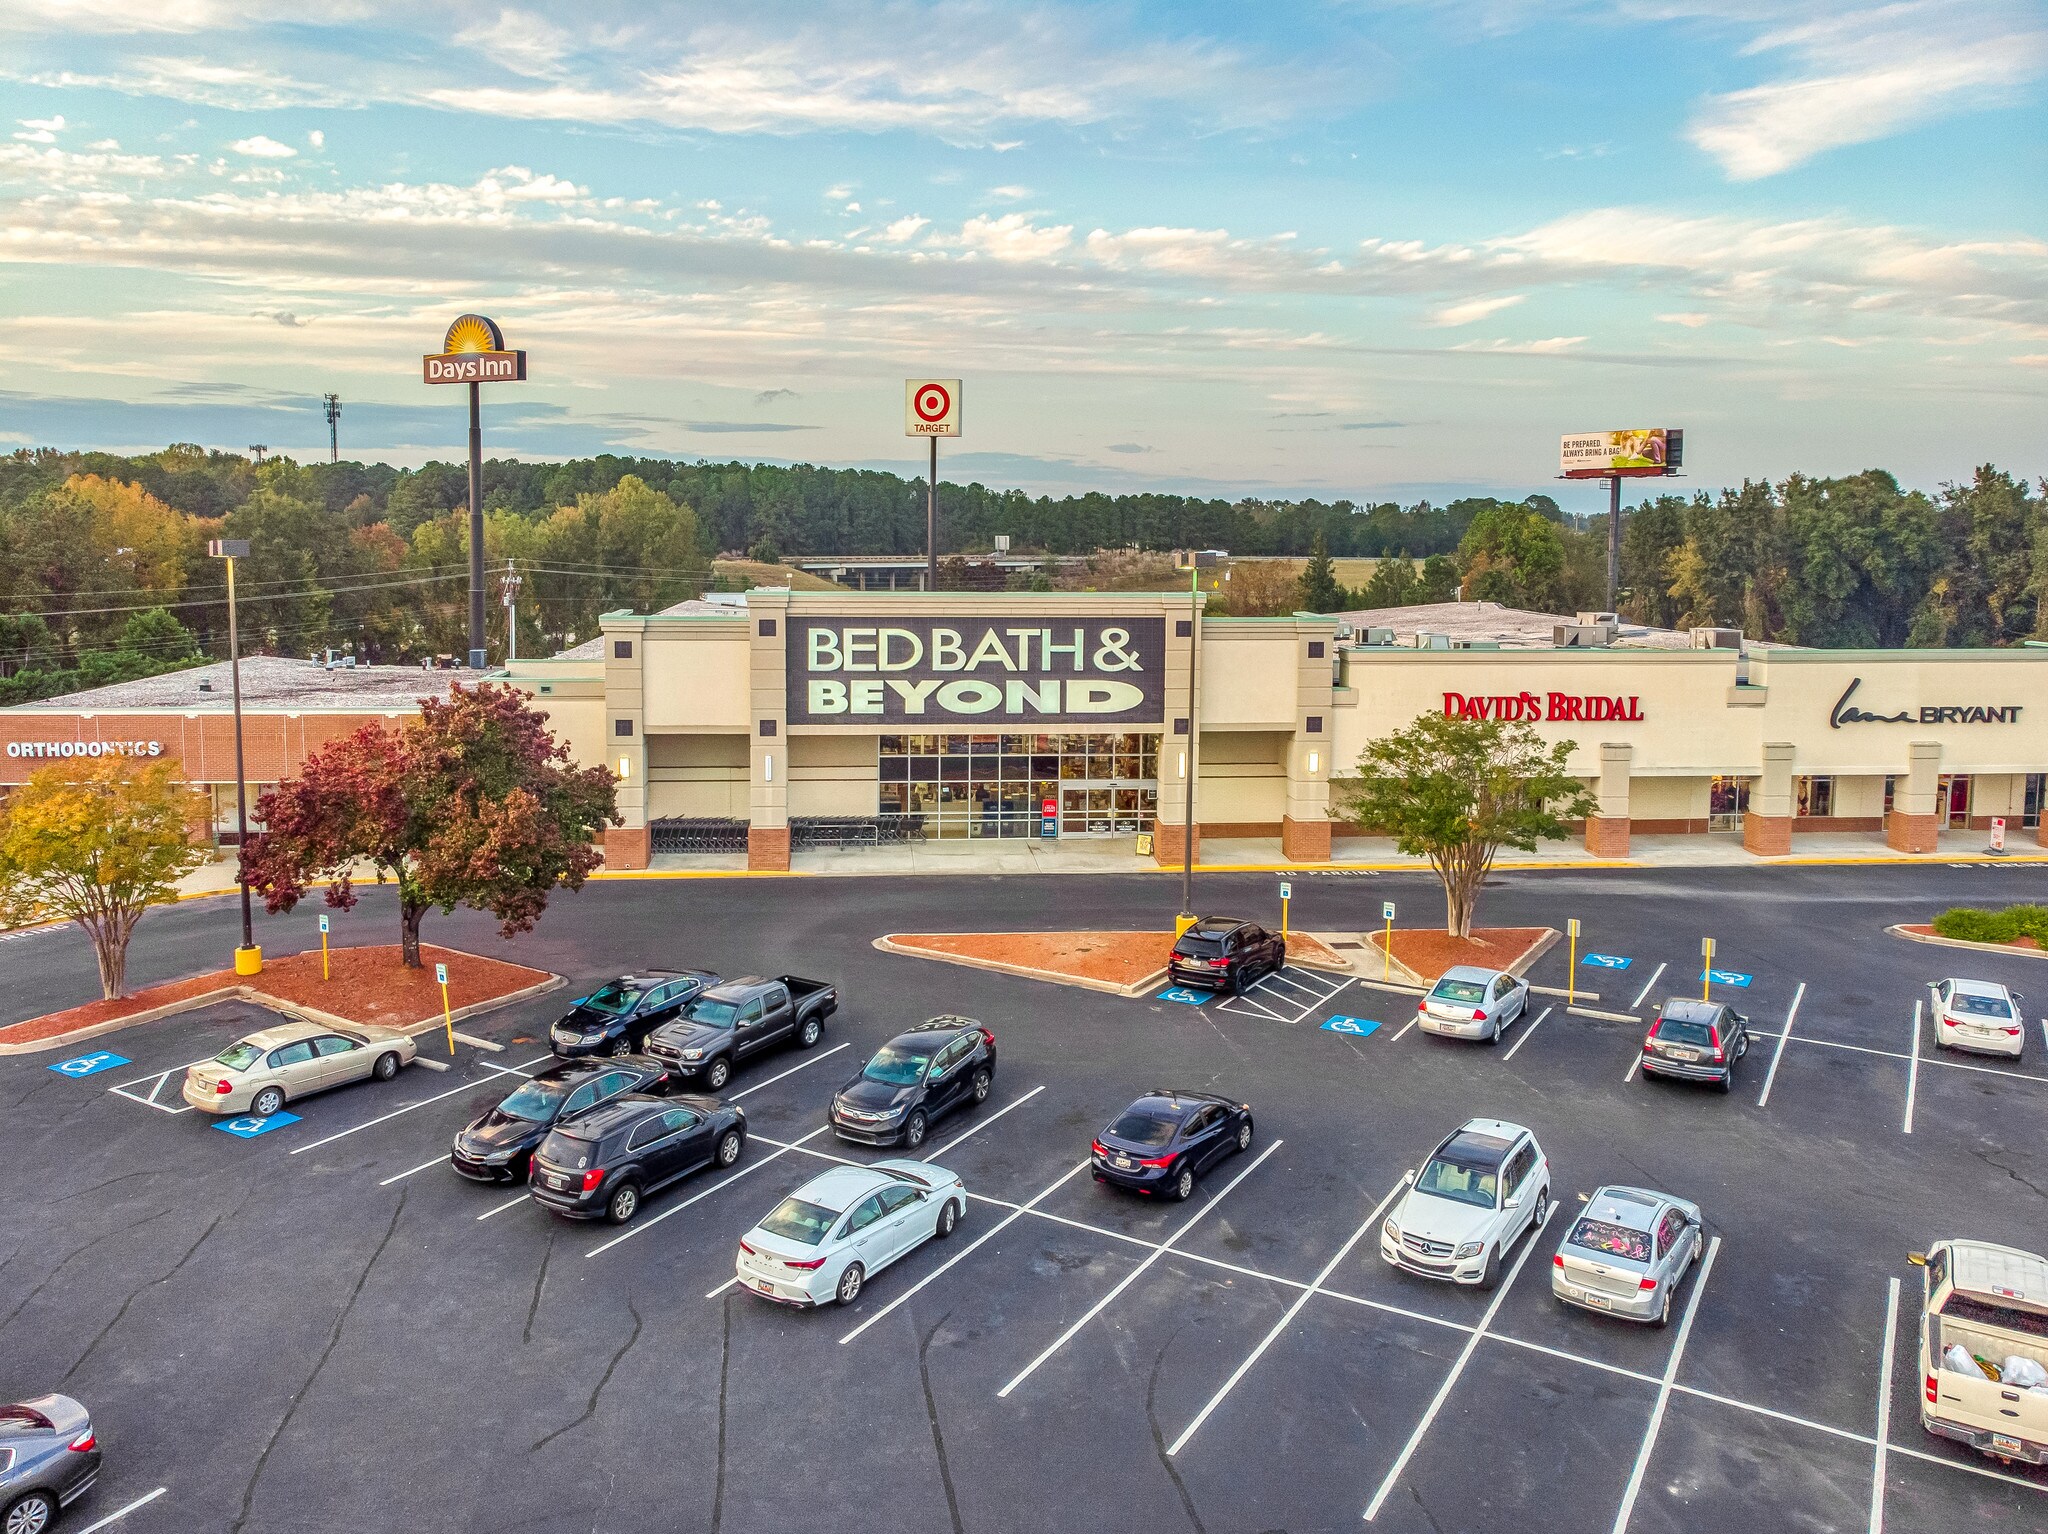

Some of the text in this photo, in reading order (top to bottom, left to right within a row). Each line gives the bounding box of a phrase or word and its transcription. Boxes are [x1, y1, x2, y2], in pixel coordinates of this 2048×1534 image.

[429, 357, 512, 380] Days Inn
[914, 424, 950, 432] TARGET
[1562, 449, 1584, 458] ALWAYS
[1584, 448, 1602, 456] BRING
[1563, 441, 1571, 449] BE
[807, 626, 1145, 672] BED BATH &
[807, 679, 1146, 714] BEYOND
[1442, 691, 1645, 721] DAVID'S BRIDAL
[1920, 706, 2024, 724] BRYANT
